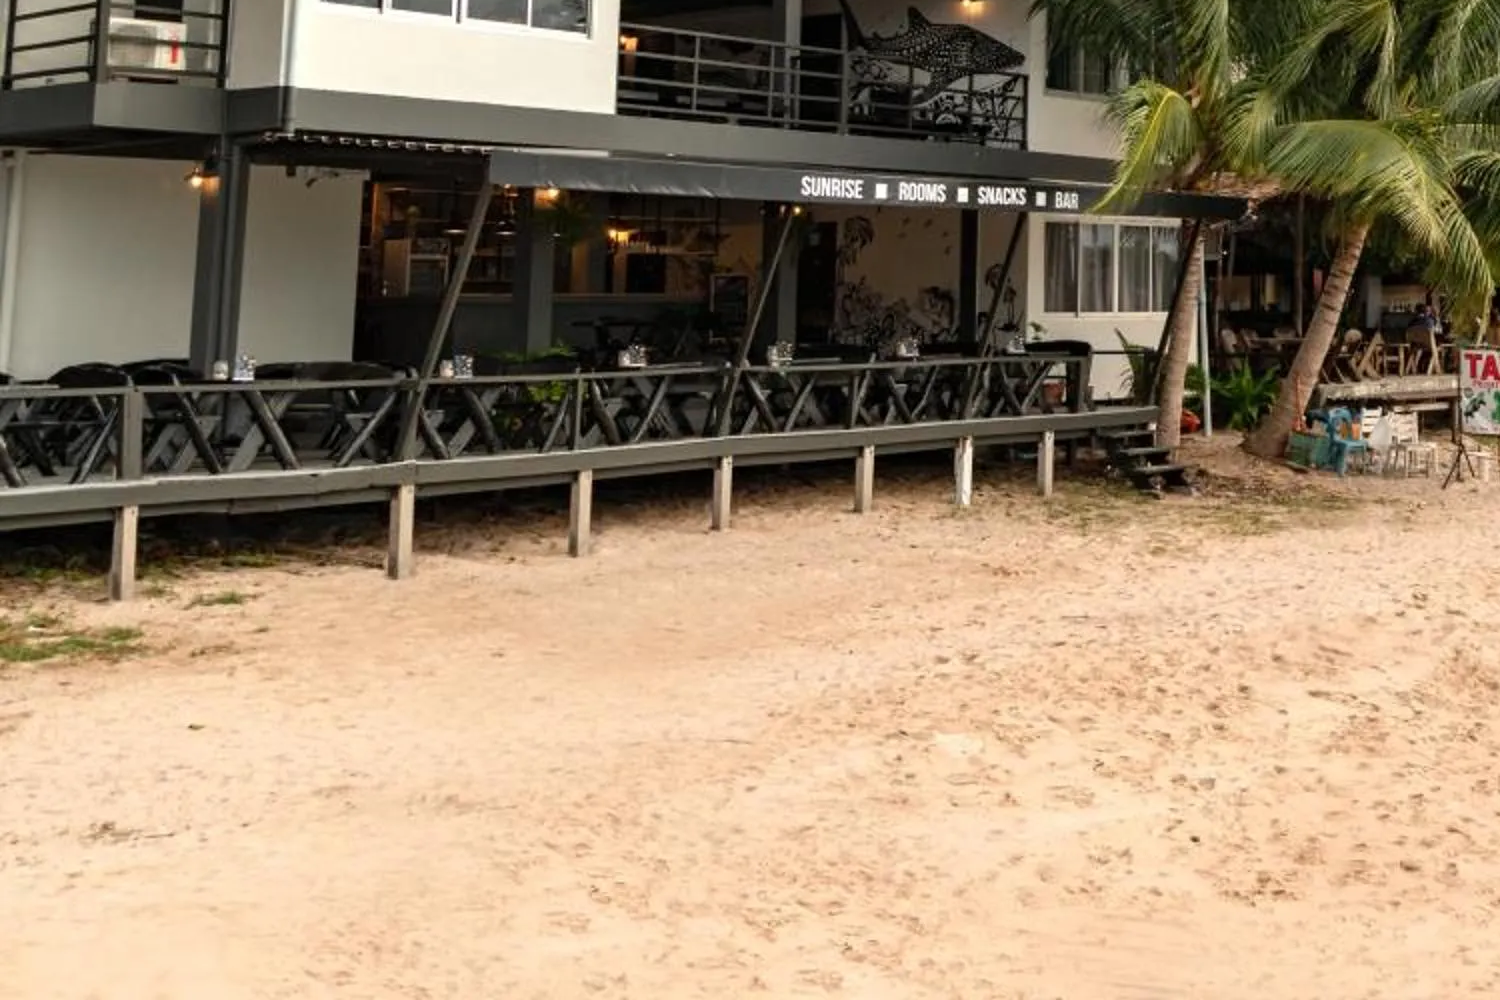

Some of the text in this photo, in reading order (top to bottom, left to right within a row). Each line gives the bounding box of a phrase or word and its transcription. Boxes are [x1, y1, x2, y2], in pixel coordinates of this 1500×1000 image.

[801, 175, 1079, 209] SUNRISE ROOMS SNACKS BAR
